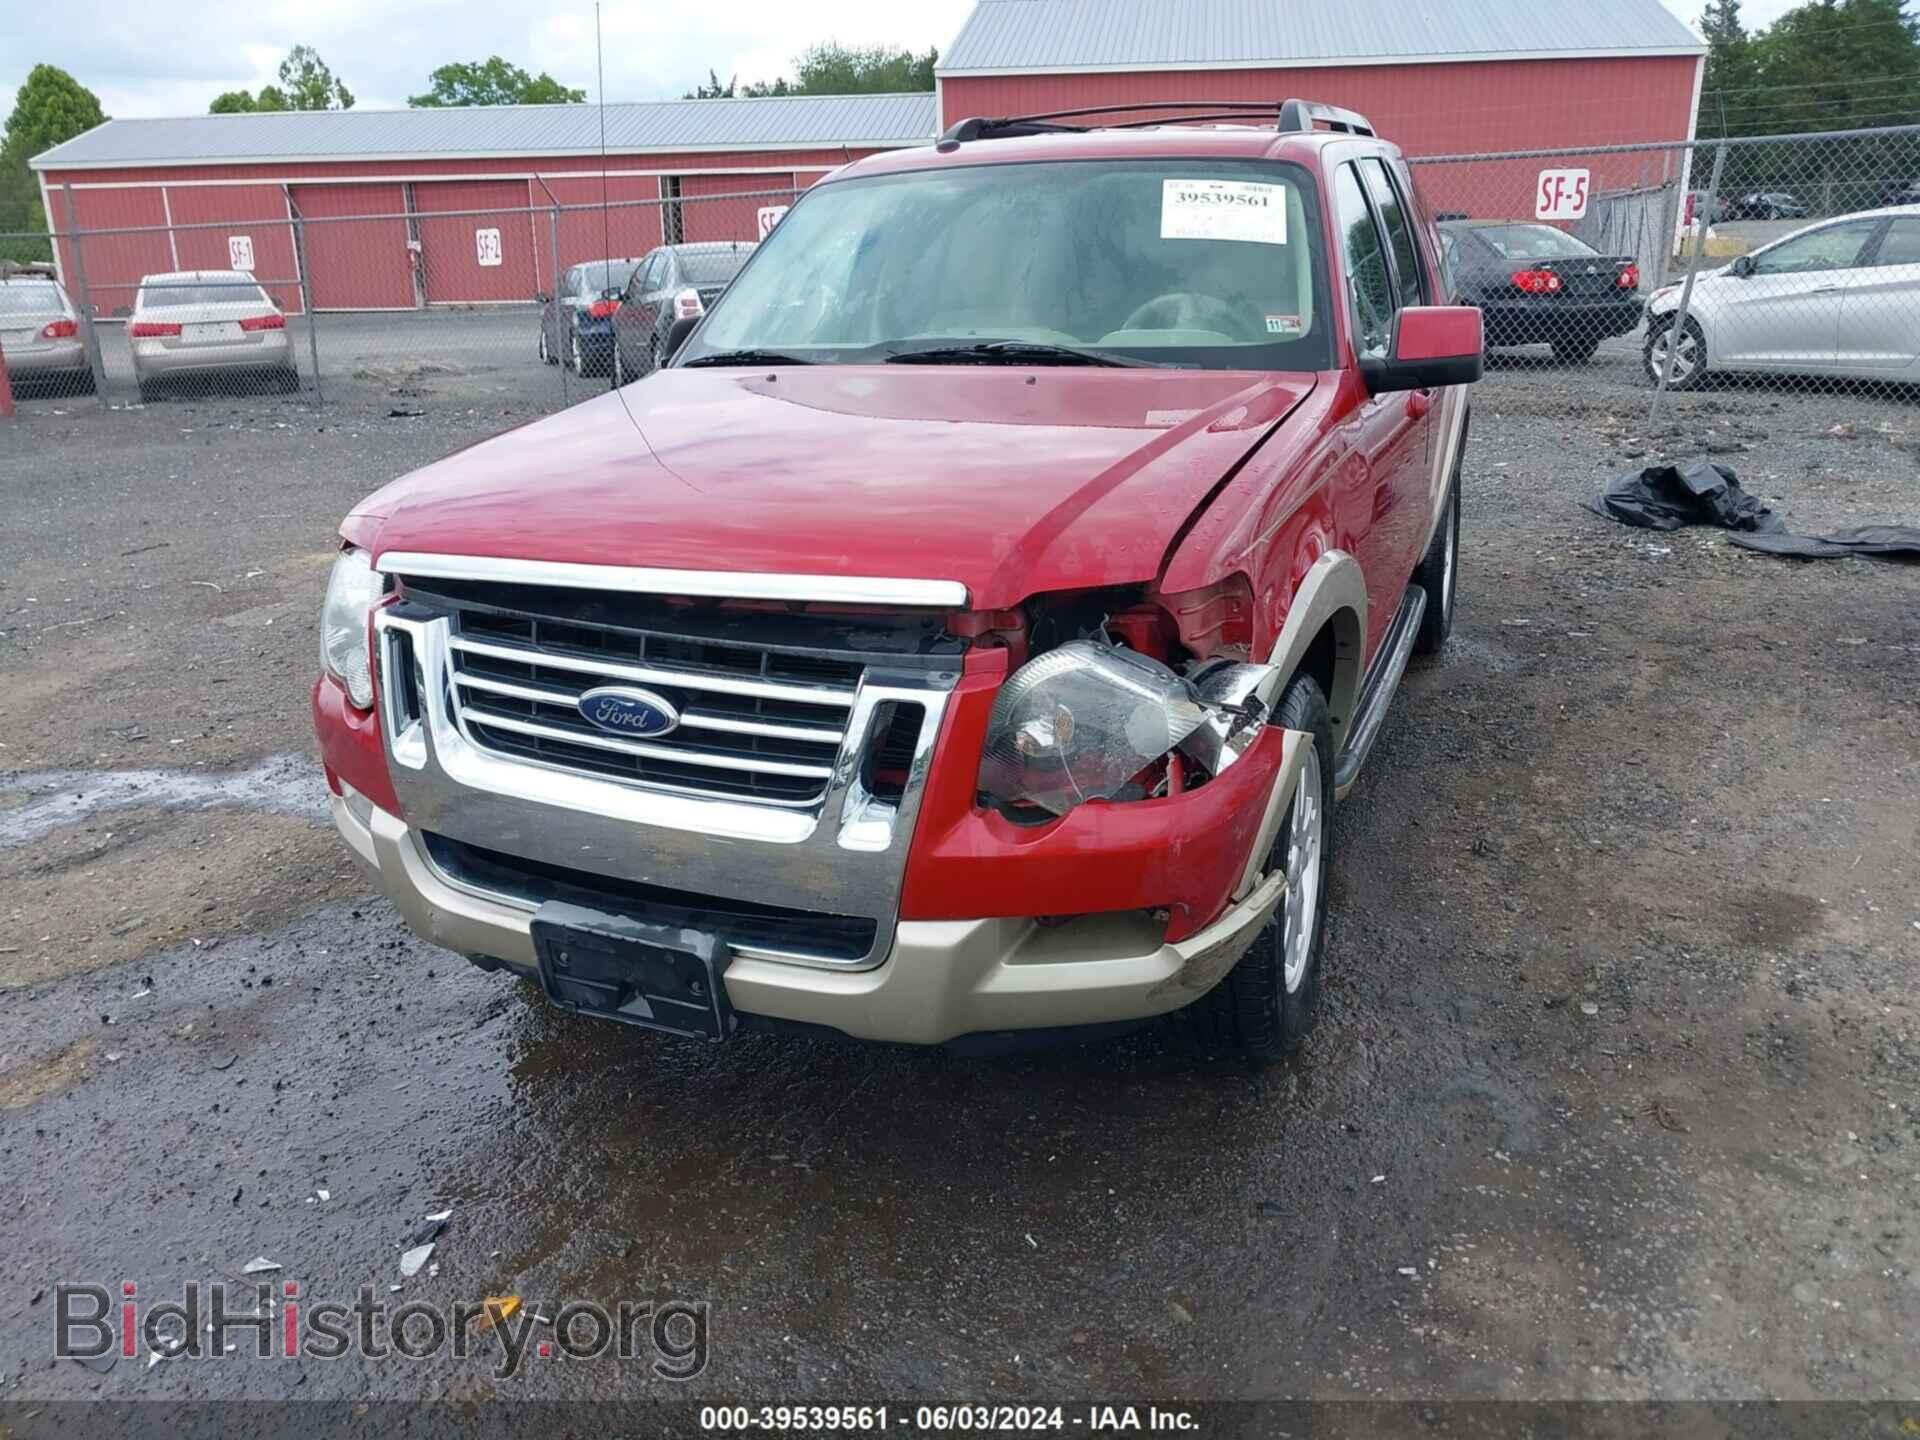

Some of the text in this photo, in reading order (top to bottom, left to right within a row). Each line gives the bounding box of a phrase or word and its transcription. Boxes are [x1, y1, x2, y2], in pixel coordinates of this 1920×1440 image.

[1176, 191, 1268, 207] 39539561
[1540, 176, 1586, 212] SF-5
[231, 241, 252, 265] SF-1
[479, 234, 500, 260] SF-2
[596, 697, 649, 728] Ford
